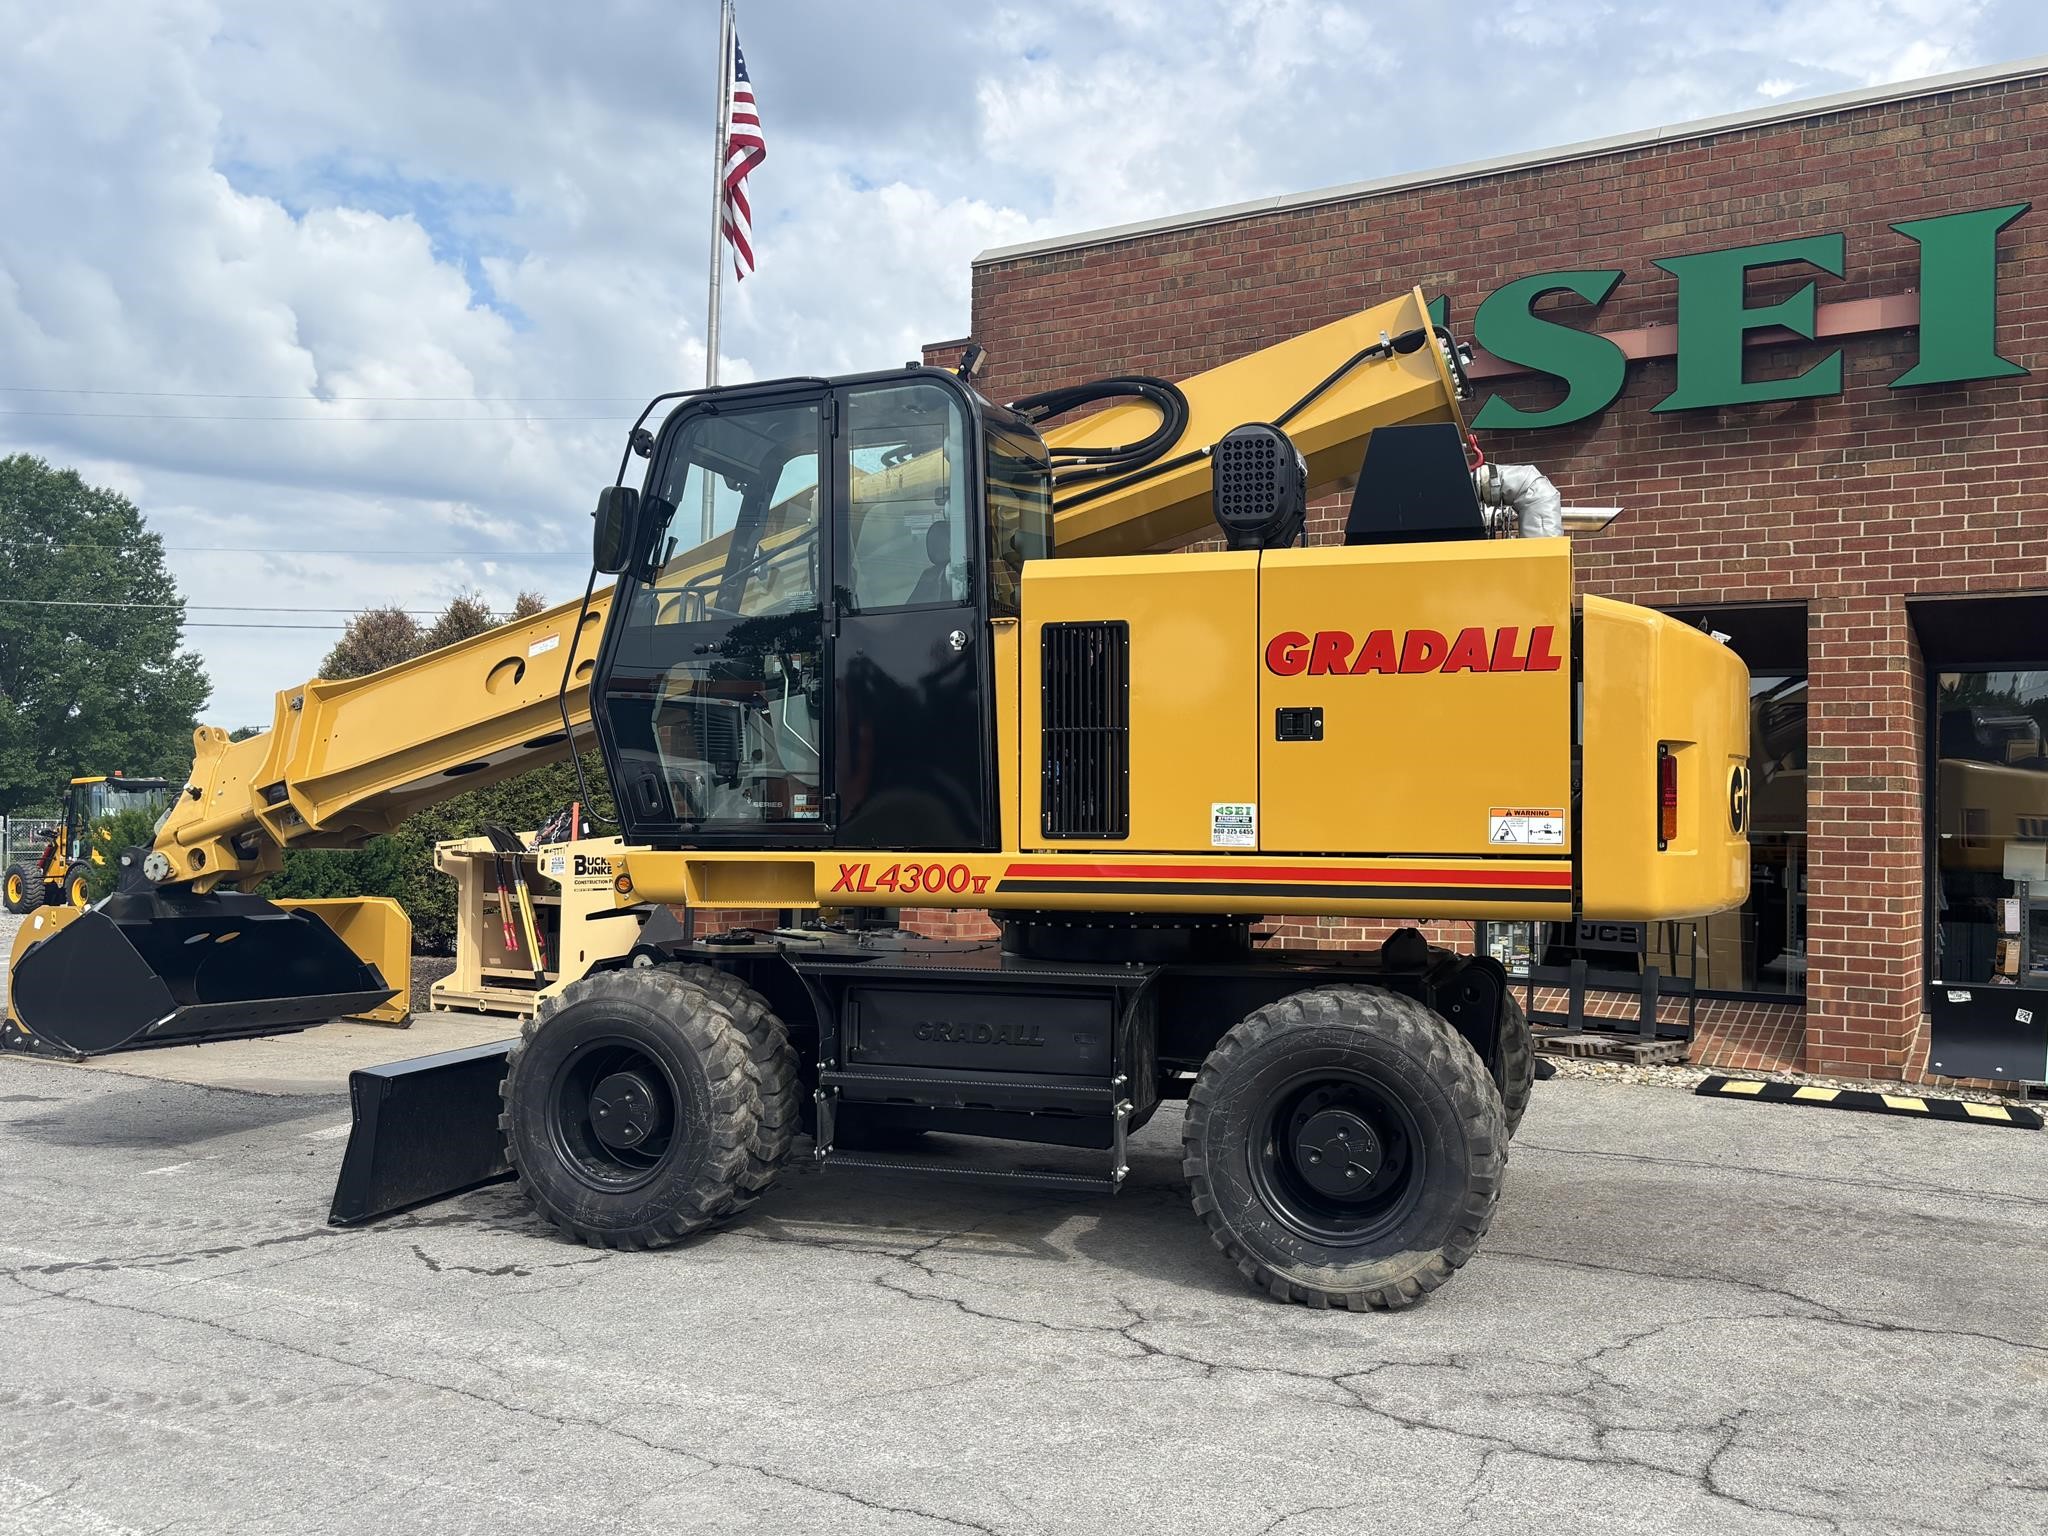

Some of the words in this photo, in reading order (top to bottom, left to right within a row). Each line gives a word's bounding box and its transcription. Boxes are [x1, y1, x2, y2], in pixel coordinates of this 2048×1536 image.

[1469, 202, 2032, 430] SEI
[1265, 626, 1562, 677] GRADALL
[1224, 806, 1252, 816] SEI
[1580, 924, 1638, 944] JCB
[913, 1020, 1046, 1047] GRADALL
